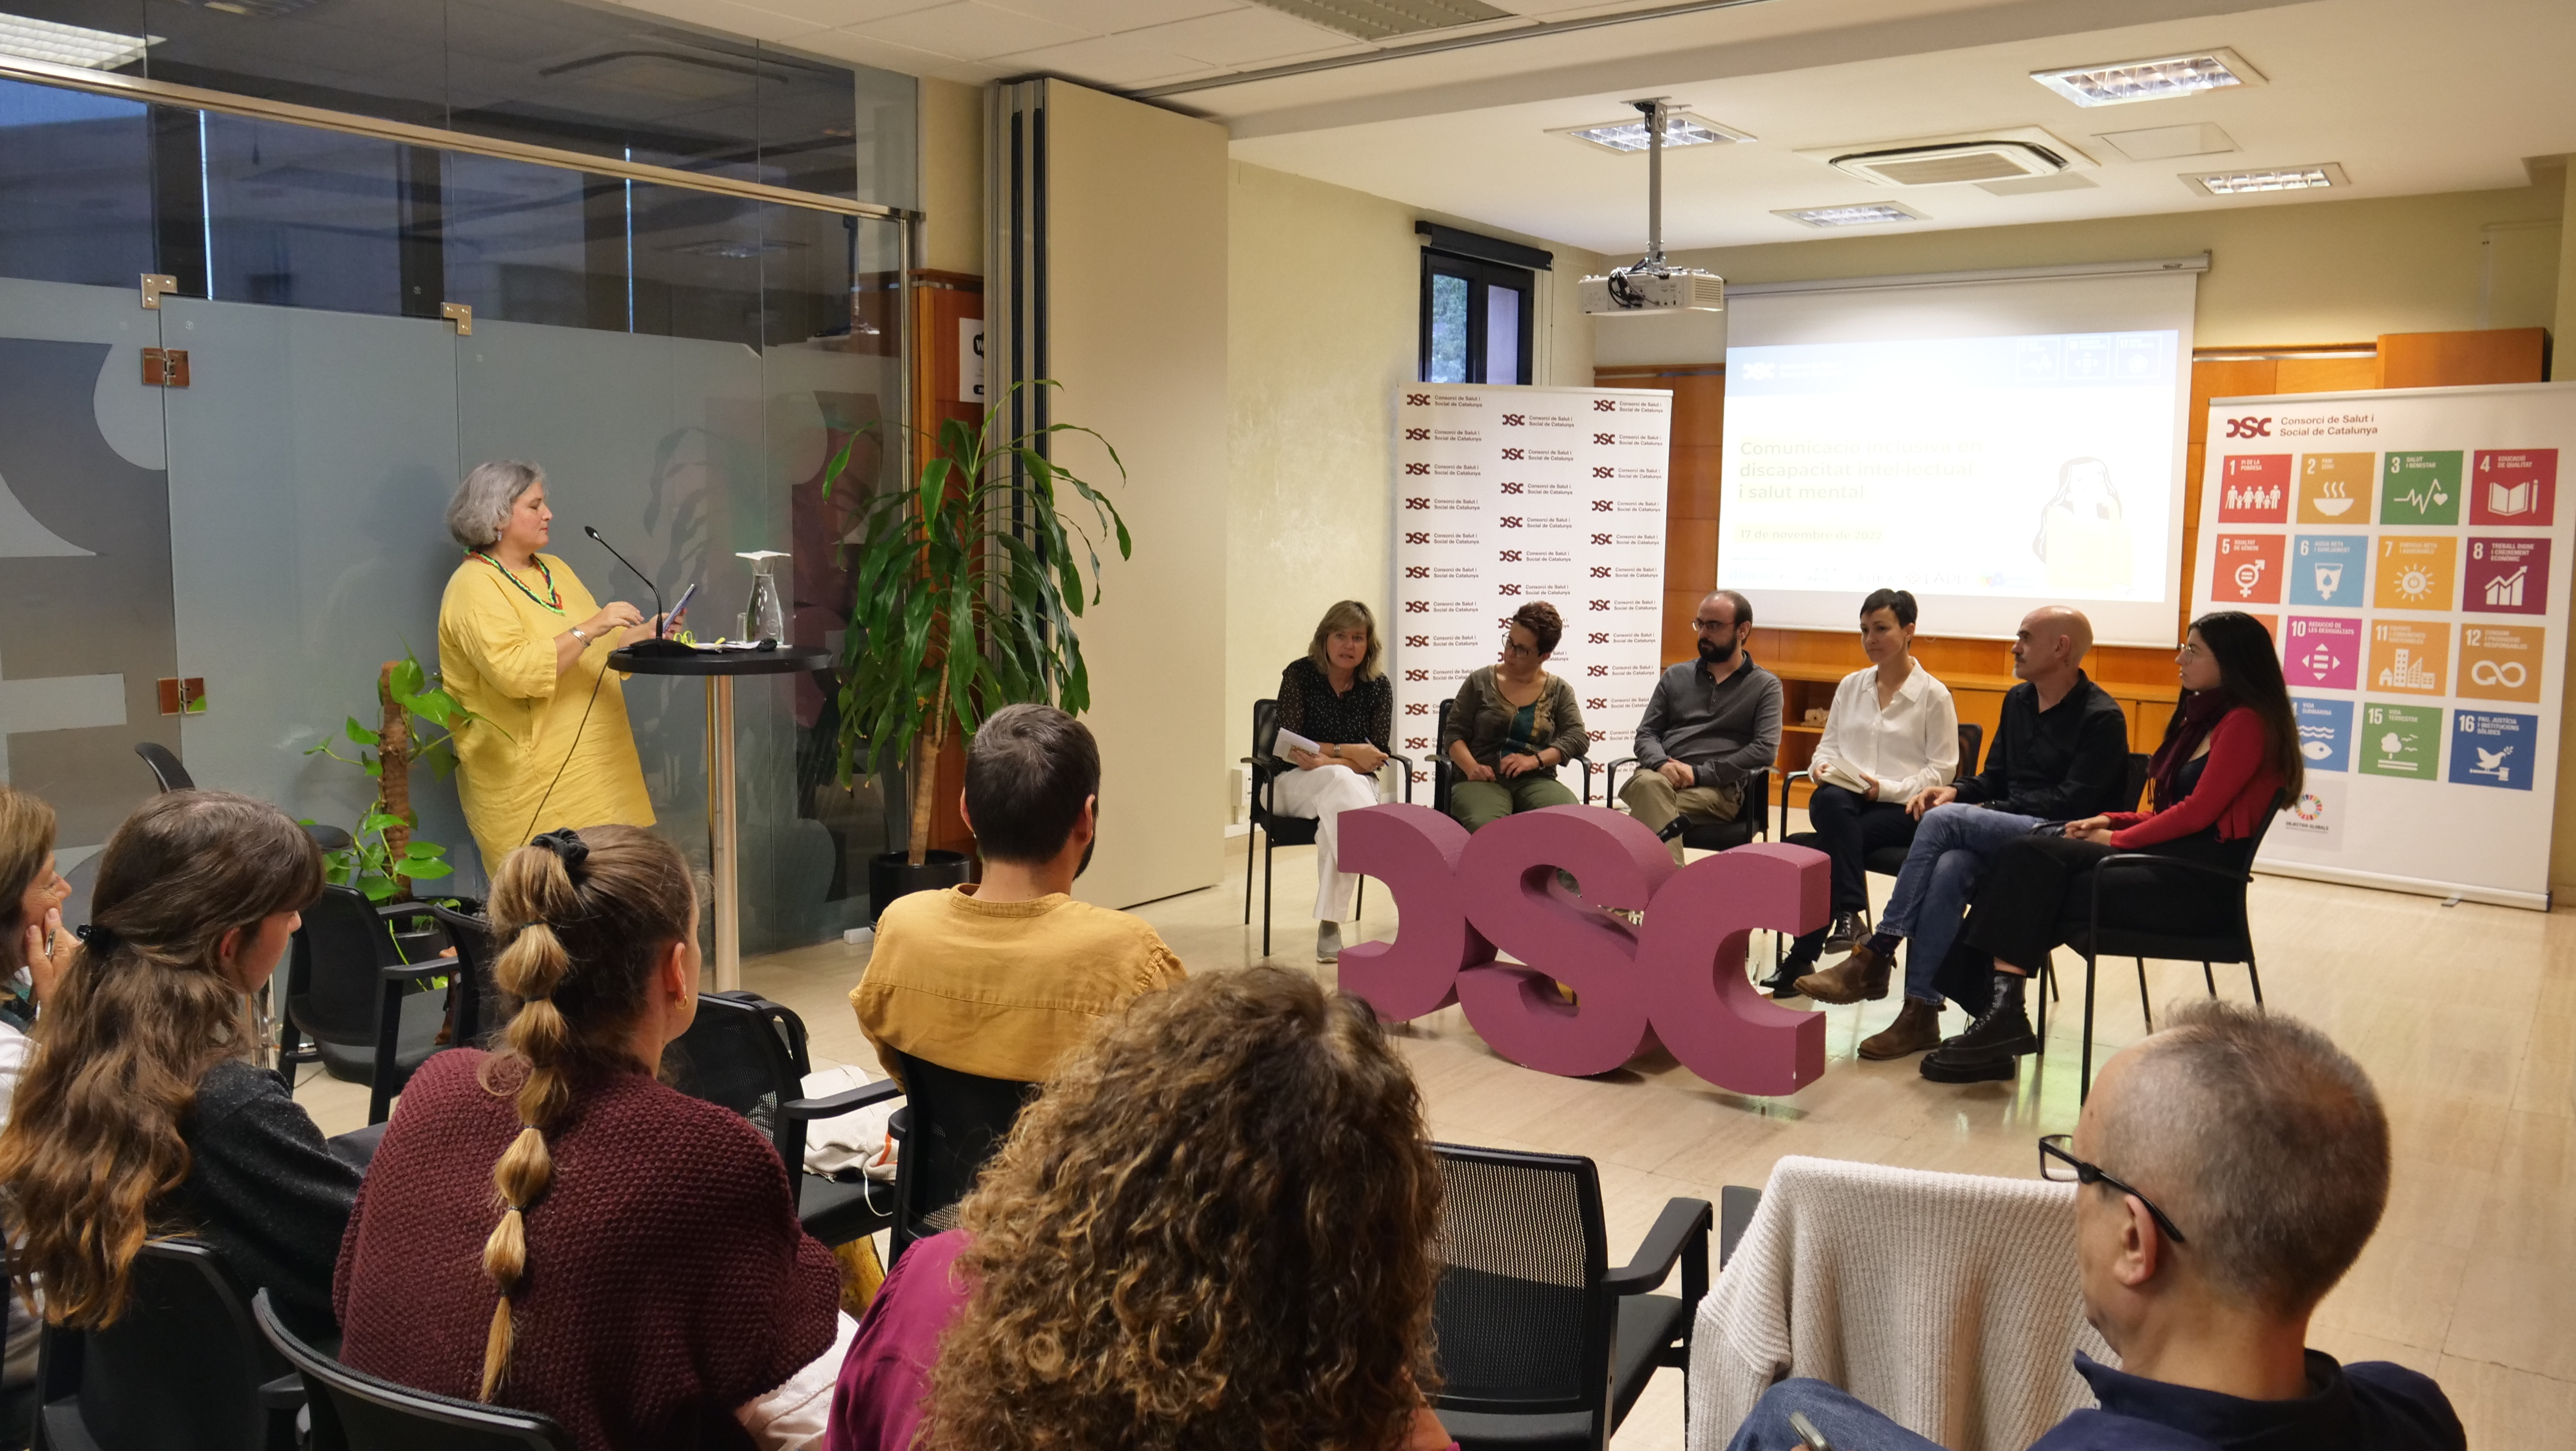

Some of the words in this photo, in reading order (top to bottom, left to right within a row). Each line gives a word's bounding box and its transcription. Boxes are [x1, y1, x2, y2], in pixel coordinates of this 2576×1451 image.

[2281, 416, 2325, 425] Consorci
[2342, 414, 2368, 423] Salut
[2280, 427, 2309, 436] Social
[2328, 426, 2378, 436] Catalunya
[1739, 462, 1852, 479] discapacitat
[2230, 460, 2236, 476] 1
[2307, 458, 2316, 475] 2
[2391, 457, 2400, 474] 3
[2480, 455, 2490, 472] 4
[1739, 484, 1743, 498] i
[1749, 485, 1793, 498] salut
[1799, 485, 1864, 498] mental
[1740, 530, 1751, 539] 17
[1755, 530, 1769, 539] de
[1772, 530, 1832, 540] novembre
[1836, 530, 1851, 540] de
[1854, 531, 1882, 540] 2022
[2222, 538, 2230, 555] 5
[2300, 540, 2309, 556] 6
[2385, 541, 2393, 557] 7
[2473, 543, 2484, 560] 8
[2292, 621, 2306, 637] 10
[2376, 625, 2388, 641] 11
[2466, 629, 2481, 646] 12
[2368, 708, 2383, 725] 15
[2459, 715, 2475, 732] 16
